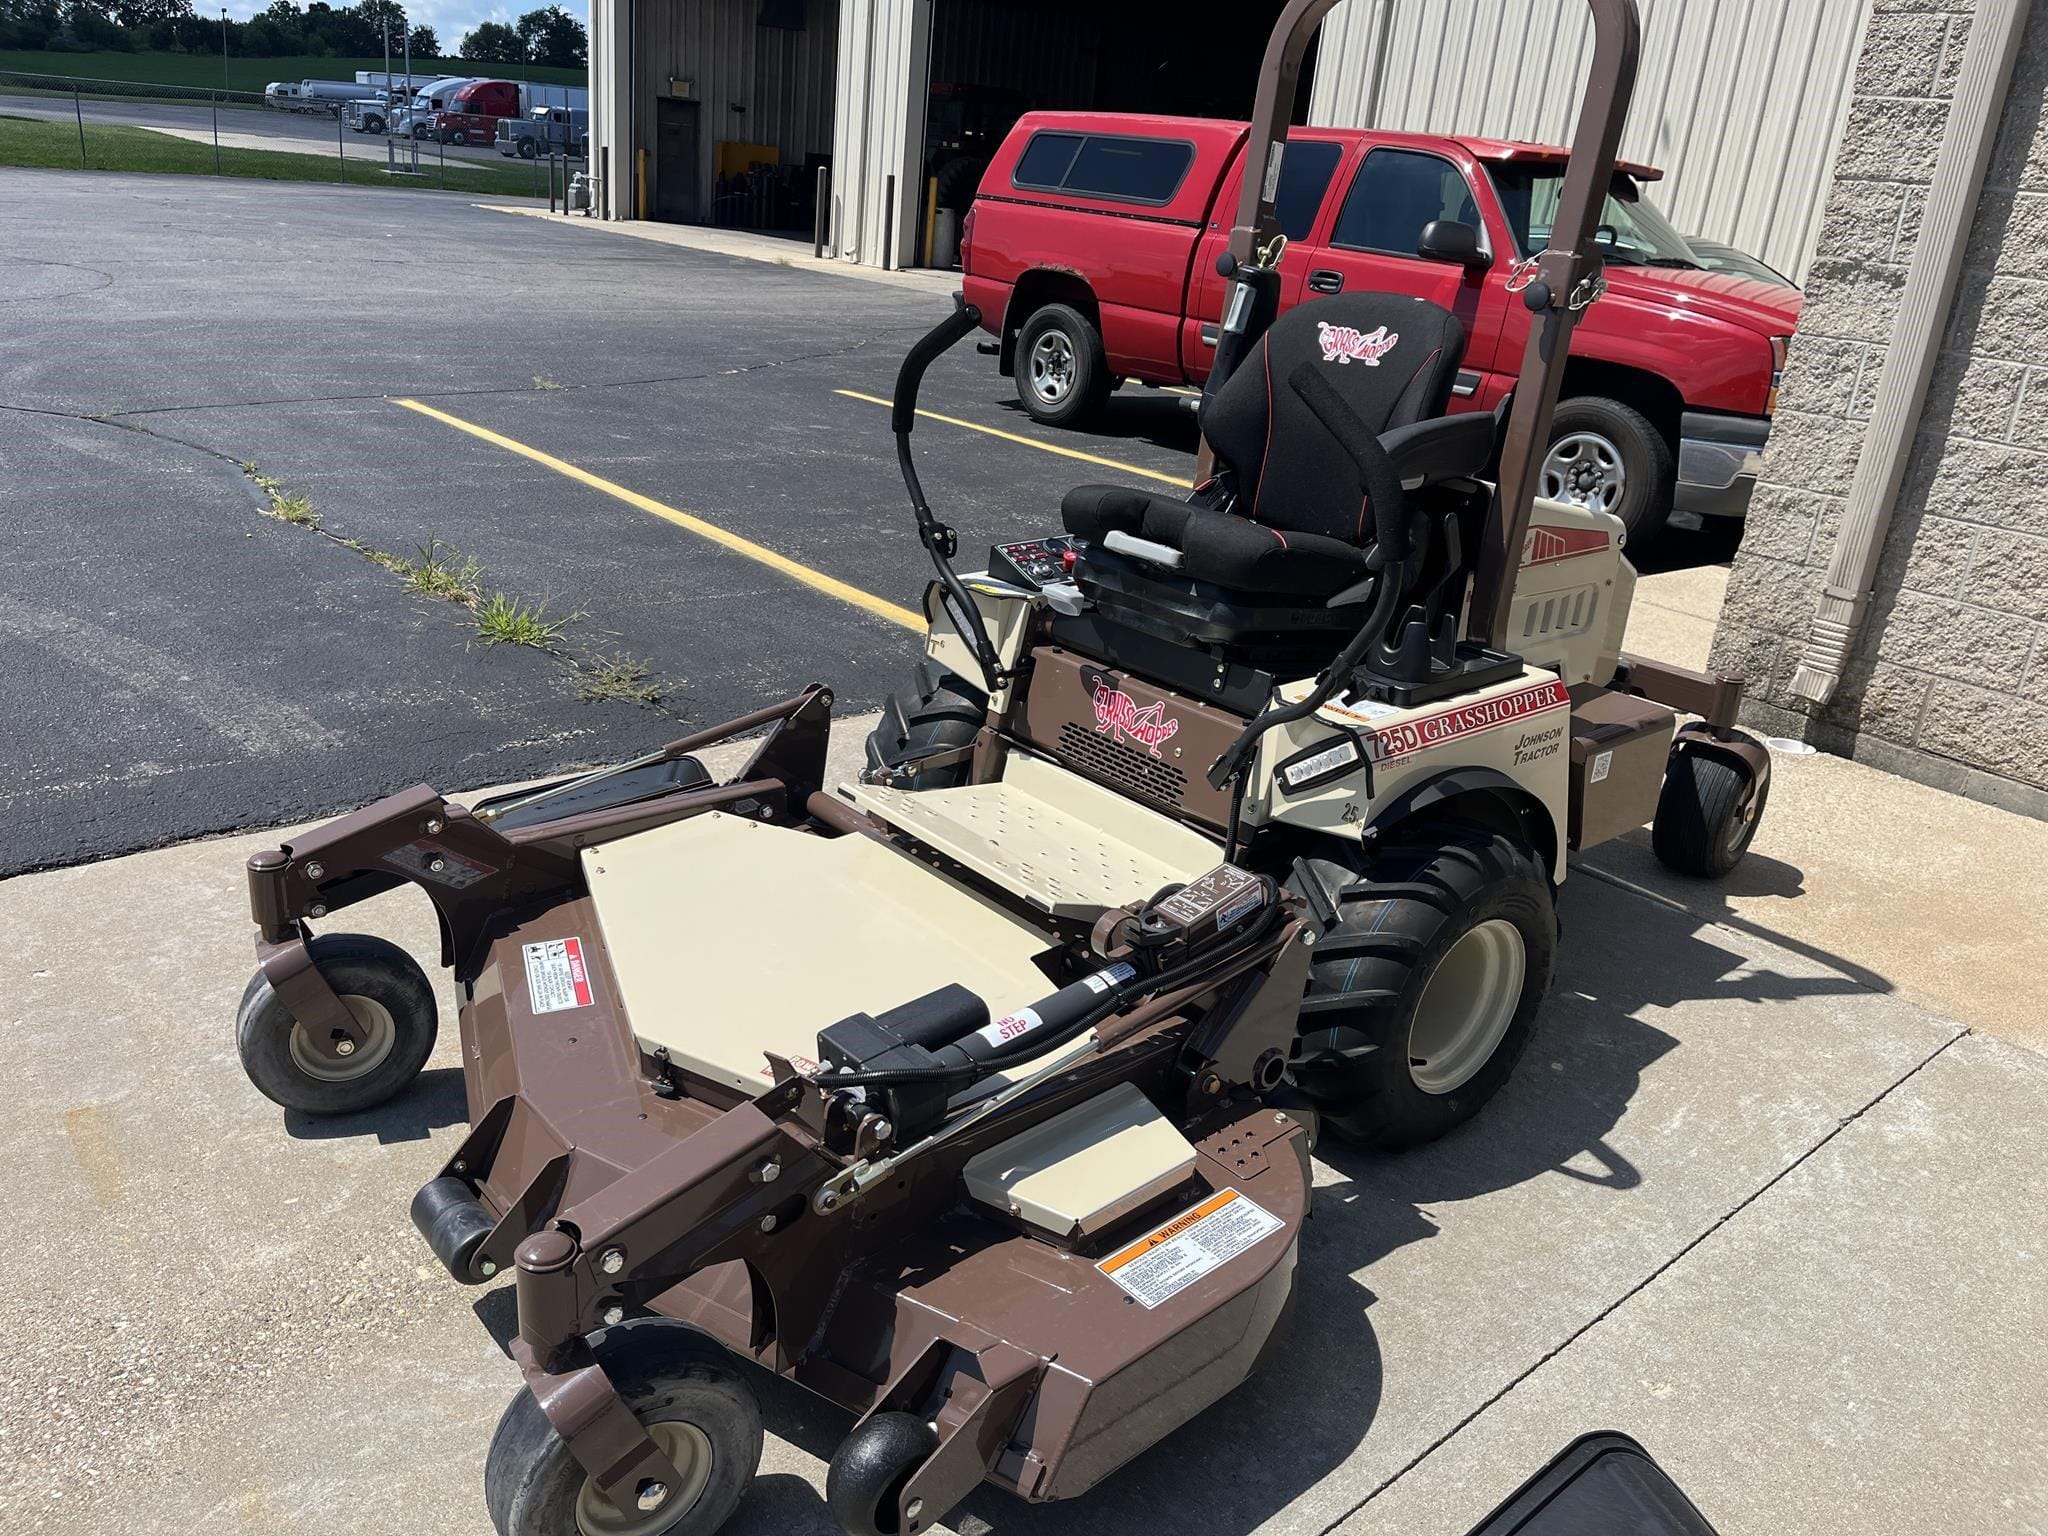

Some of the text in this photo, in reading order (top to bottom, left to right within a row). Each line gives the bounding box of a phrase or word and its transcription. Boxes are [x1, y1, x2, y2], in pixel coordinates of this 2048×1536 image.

[1366, 725, 1418, 759] 725D
[1423, 685, 1559, 740] GRASSHOPPER
[1514, 726, 1564, 751] JOHNSON
[1380, 757, 1412, 772] DIESEL
[1513, 743, 1560, 767] TRACTOR
[1341, 802, 1360, 823] 25
[572, 959, 584, 983] DANGER
[997, 1016, 1015, 1028] NO
[999, 1019, 1027, 1040] STEP
[1158, 1211, 1202, 1239] WARNING
